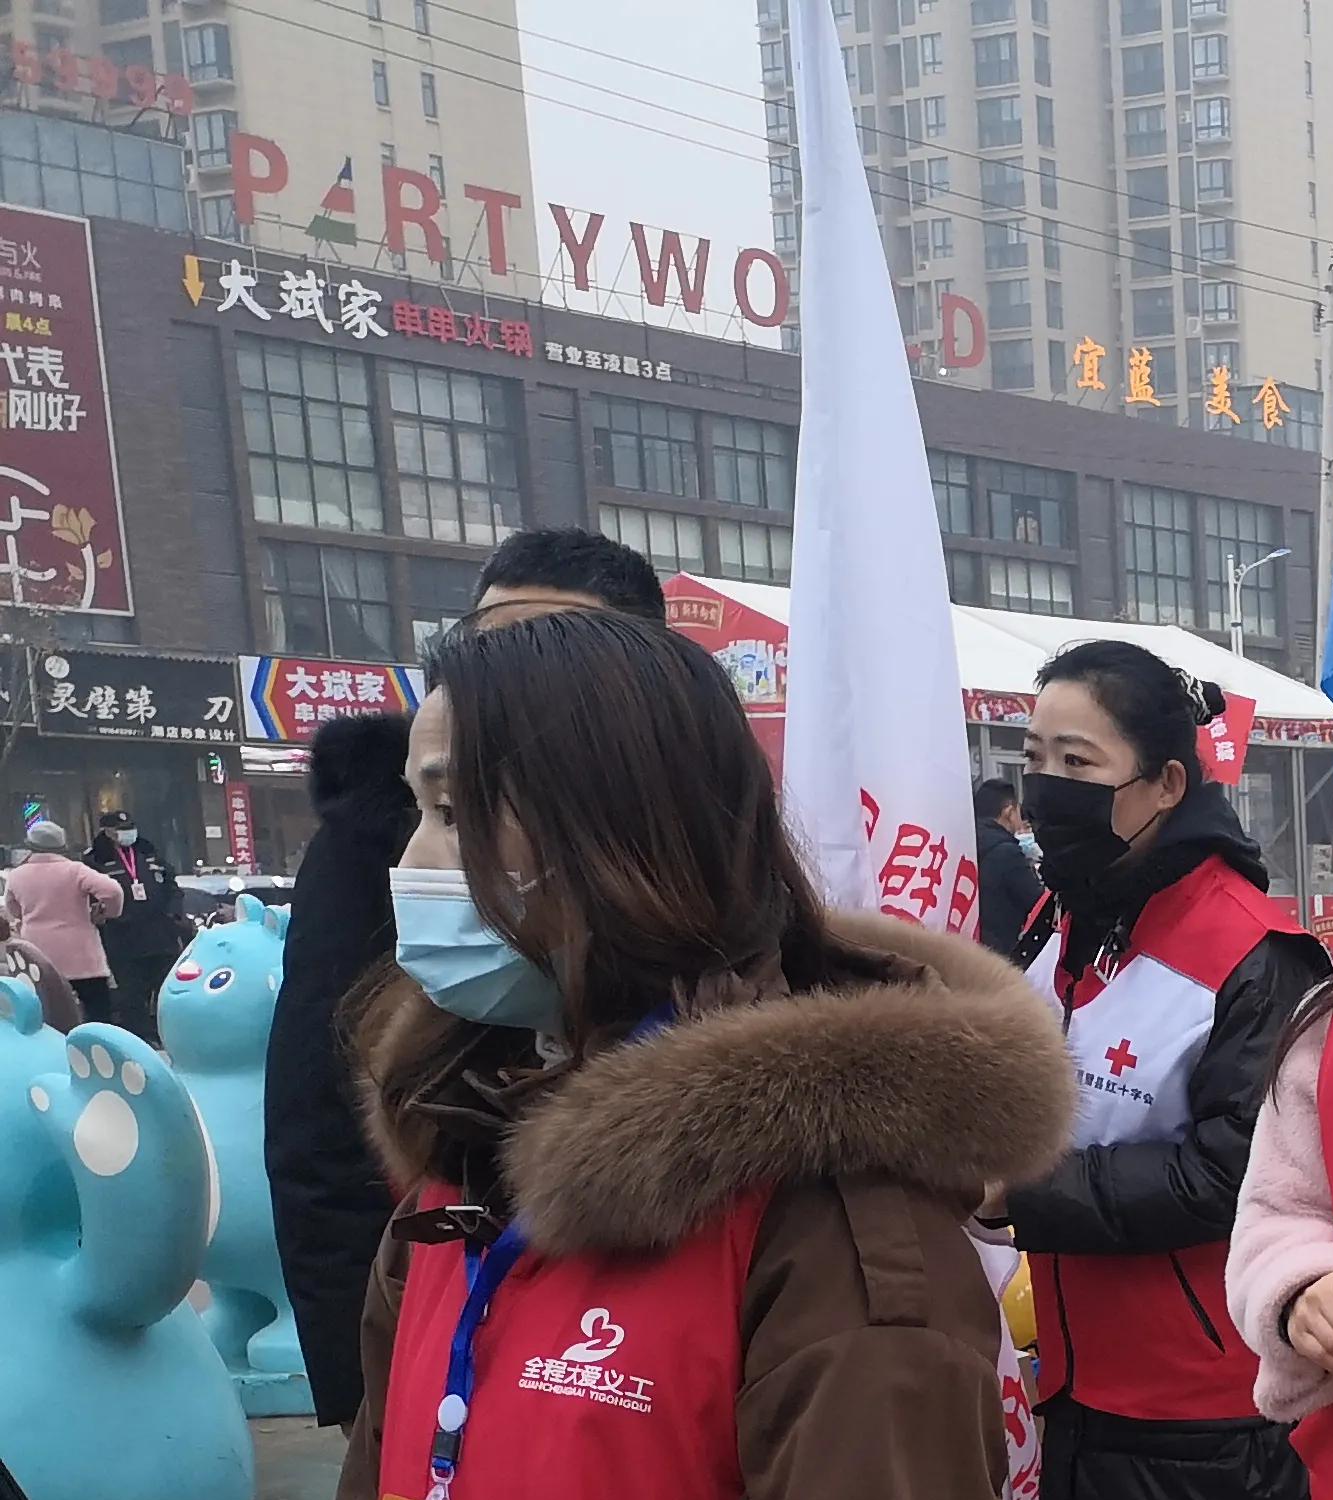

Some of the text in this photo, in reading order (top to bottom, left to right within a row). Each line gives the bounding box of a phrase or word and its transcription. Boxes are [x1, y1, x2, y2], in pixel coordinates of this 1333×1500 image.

[522, 1357, 654, 1401] 全程大爱义工
